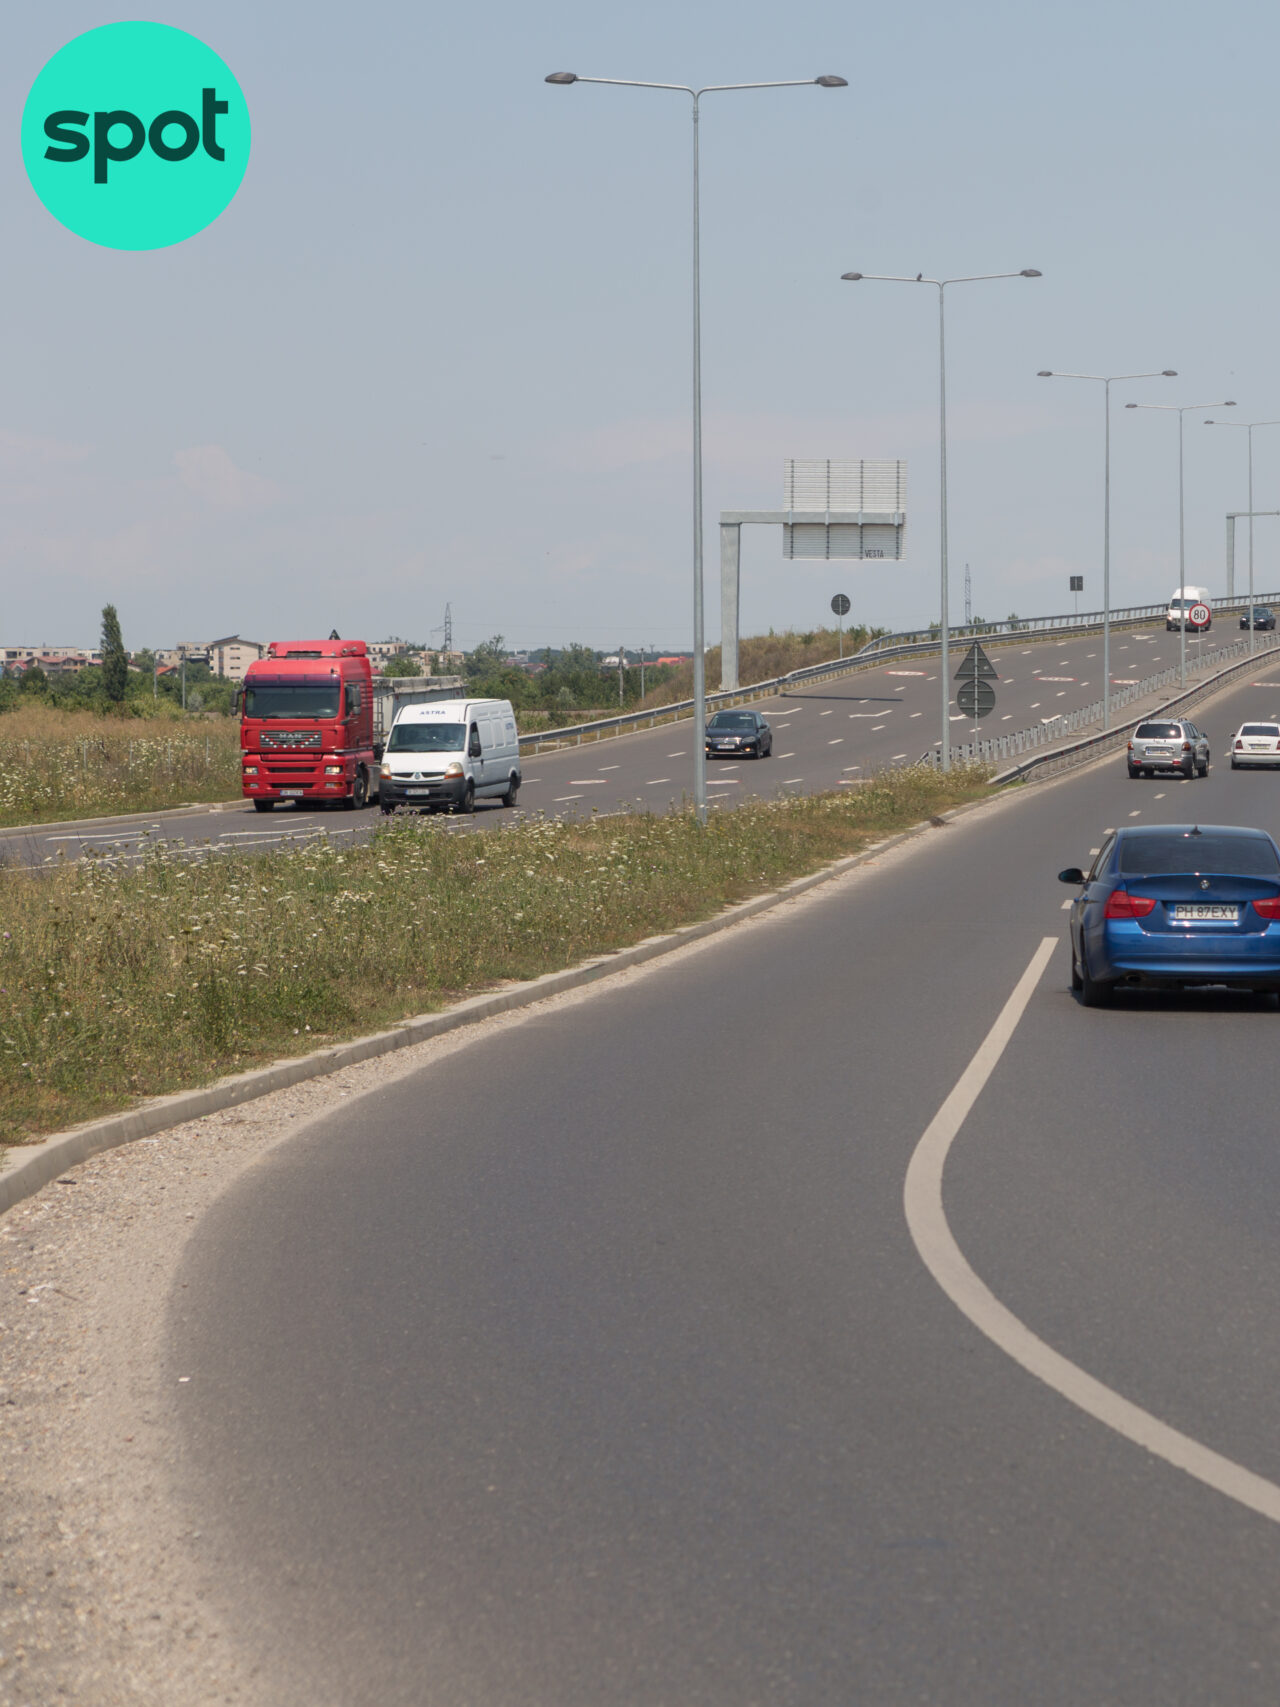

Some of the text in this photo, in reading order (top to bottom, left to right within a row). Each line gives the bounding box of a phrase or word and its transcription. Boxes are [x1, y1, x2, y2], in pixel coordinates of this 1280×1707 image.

[865, 549, 884, 558] VESTA
[1194, 609, 1205, 620] 80
[1176, 906, 1237, 918] PH 87EXY
